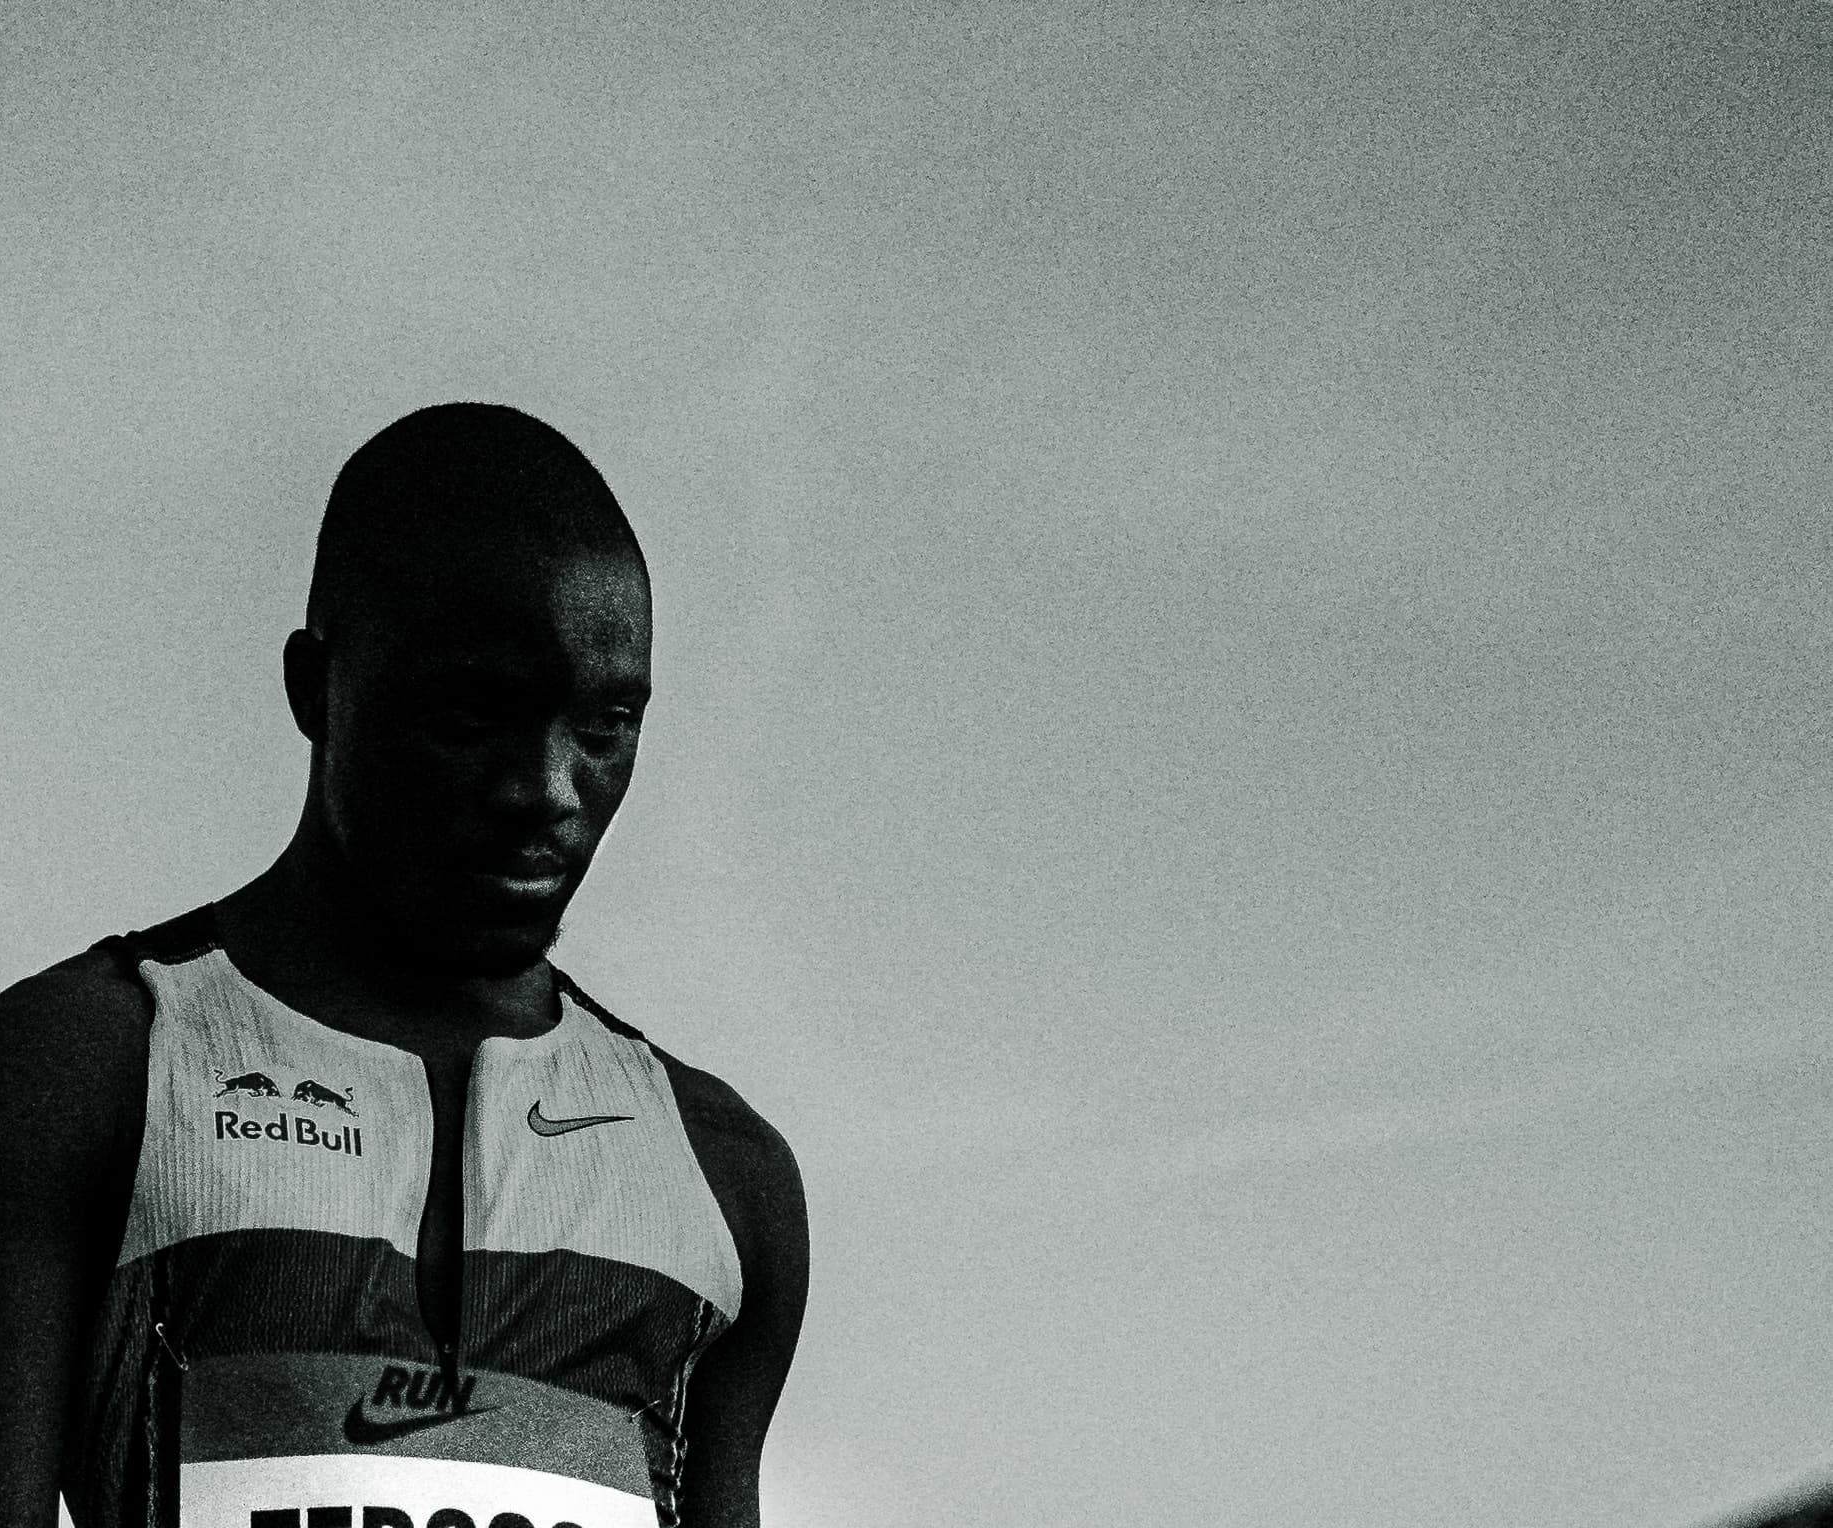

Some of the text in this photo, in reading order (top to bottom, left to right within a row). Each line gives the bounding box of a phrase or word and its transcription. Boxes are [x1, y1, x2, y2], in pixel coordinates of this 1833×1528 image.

[215, 1111, 362, 1157] Red Bull
[372, 1364, 477, 1416] RUN
